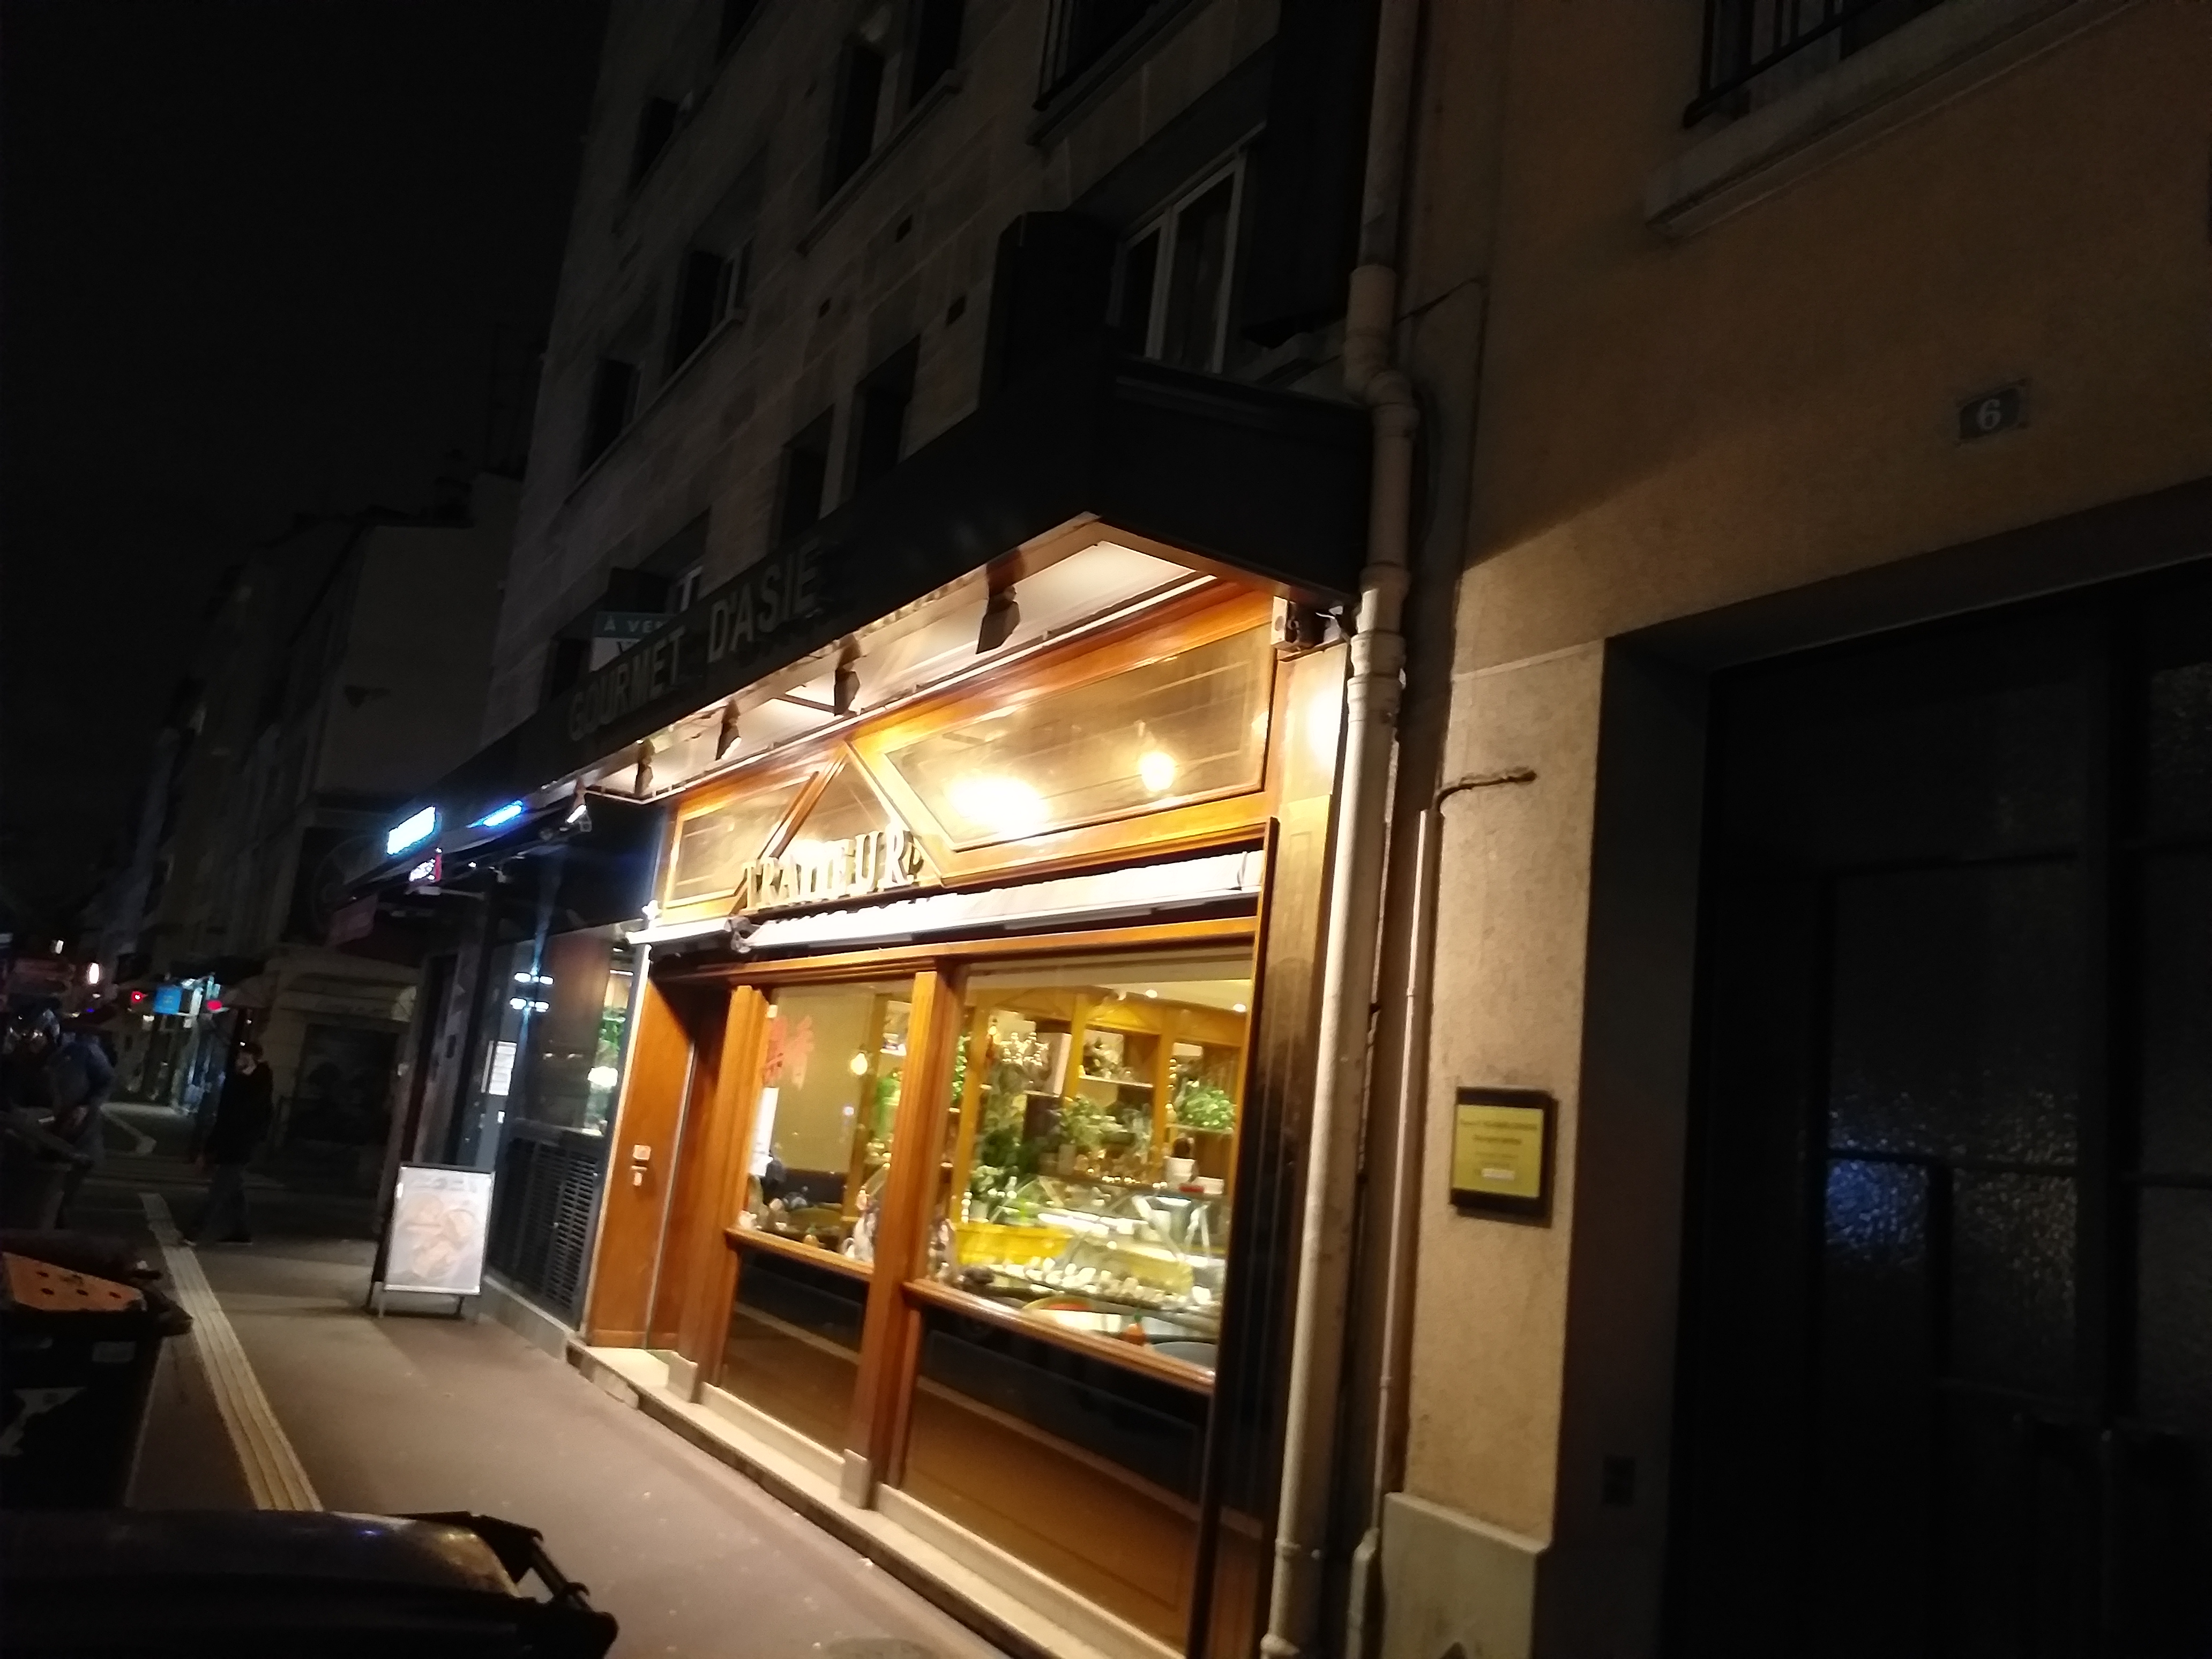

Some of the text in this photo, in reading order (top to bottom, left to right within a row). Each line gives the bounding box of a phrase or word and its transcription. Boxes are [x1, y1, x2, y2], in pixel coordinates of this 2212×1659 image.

[1976, 399, 2001, 430] 6
[567, 537, 821, 742] GOURMET D'ASIE
